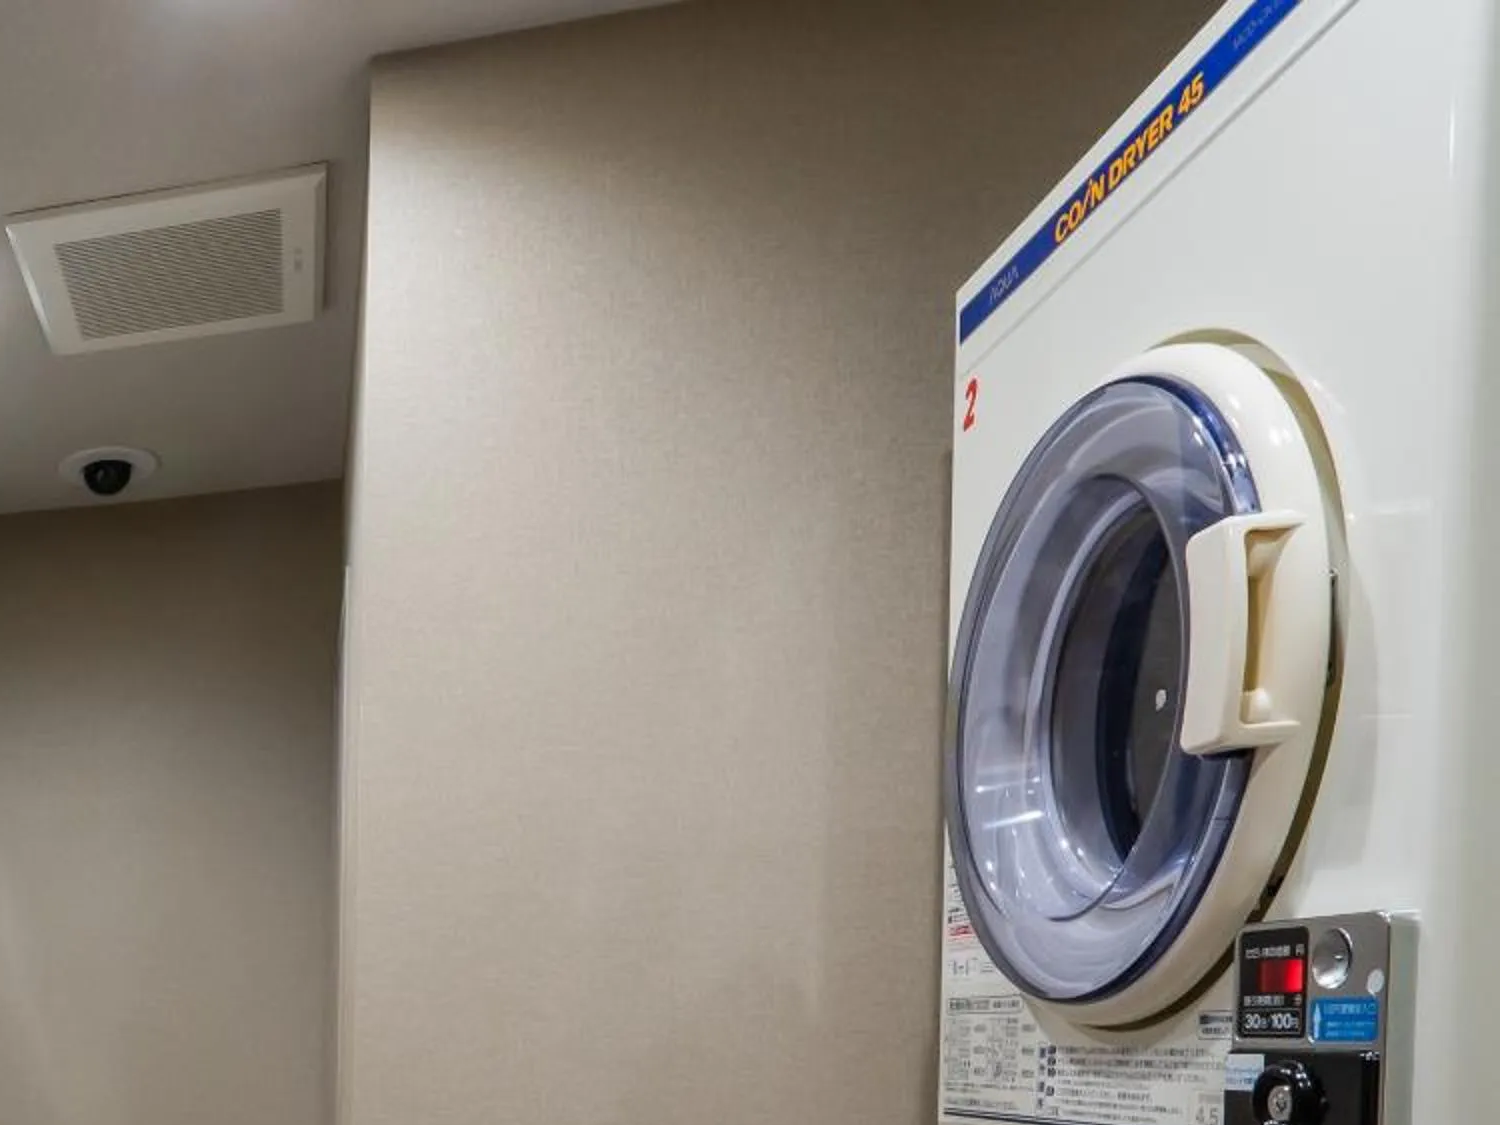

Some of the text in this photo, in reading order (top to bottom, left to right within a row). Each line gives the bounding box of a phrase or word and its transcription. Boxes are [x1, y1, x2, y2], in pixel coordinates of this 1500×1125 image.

[1107, 103, 1174, 191] DRYER
[1177, 71, 1204, 116] 45
[963, 377, 978, 432] 2
